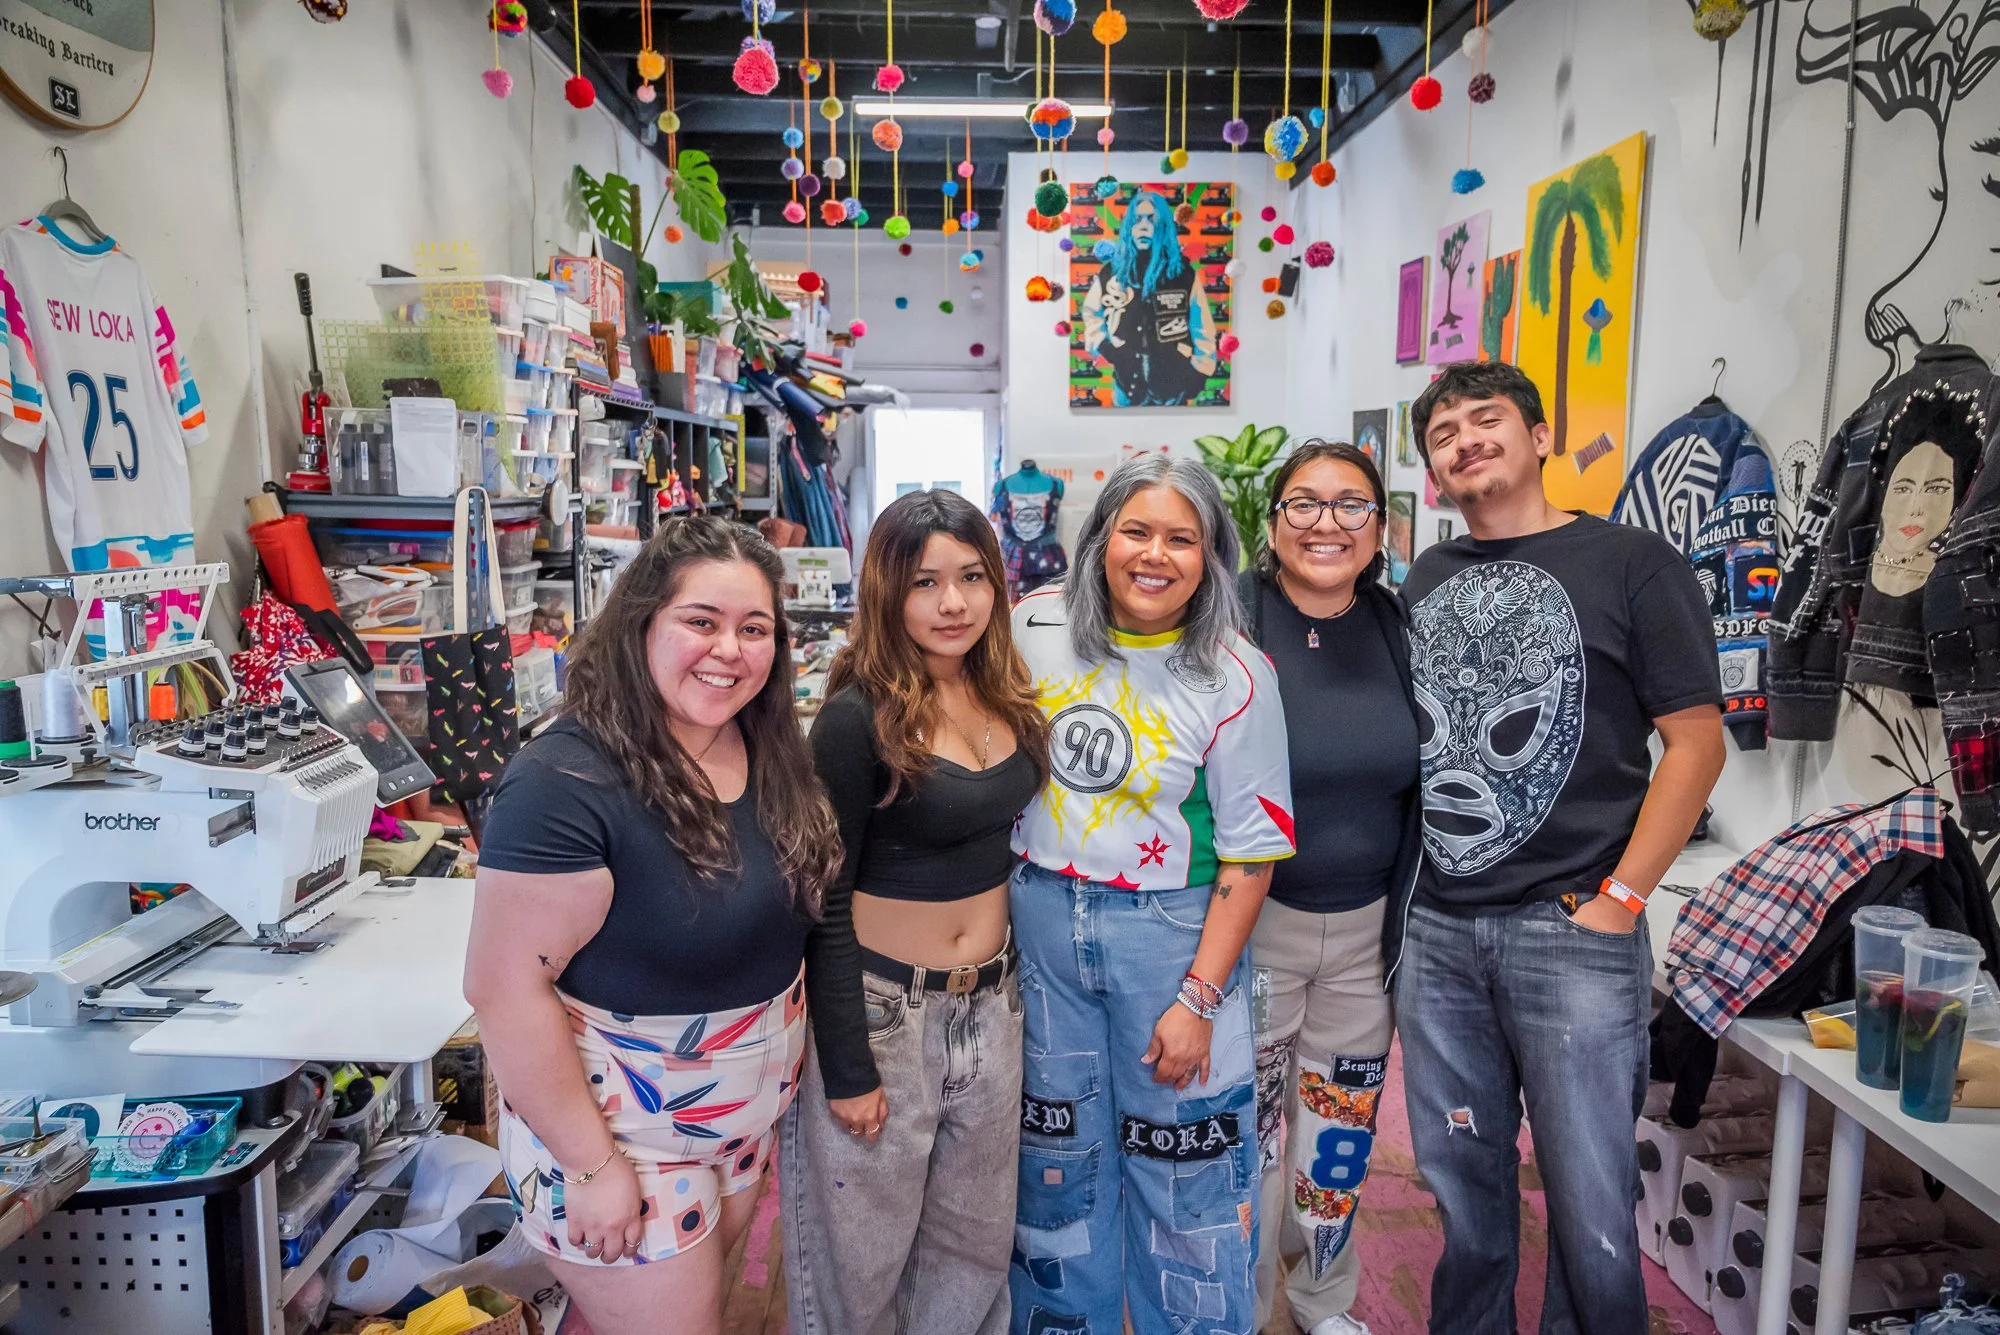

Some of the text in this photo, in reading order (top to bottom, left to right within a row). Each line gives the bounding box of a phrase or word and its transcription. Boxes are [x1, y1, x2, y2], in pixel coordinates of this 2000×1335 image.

[0, 17, 114, 77] reaking Barriers
[53, 84, 77, 111] SL
[47, 298, 137, 345] SEW LOKA
[66, 369, 140, 481] 25
[1065, 720, 1115, 779] 90
[84, 812, 161, 831] brother
[1338, 1059, 1382, 1073] Sewing
[147, 1106, 167, 1114] HAPPY
[1021, 1098, 1071, 1133] EW
[1126, 1116, 1230, 1156] LOKA
[1310, 1126, 1375, 1190] 8
